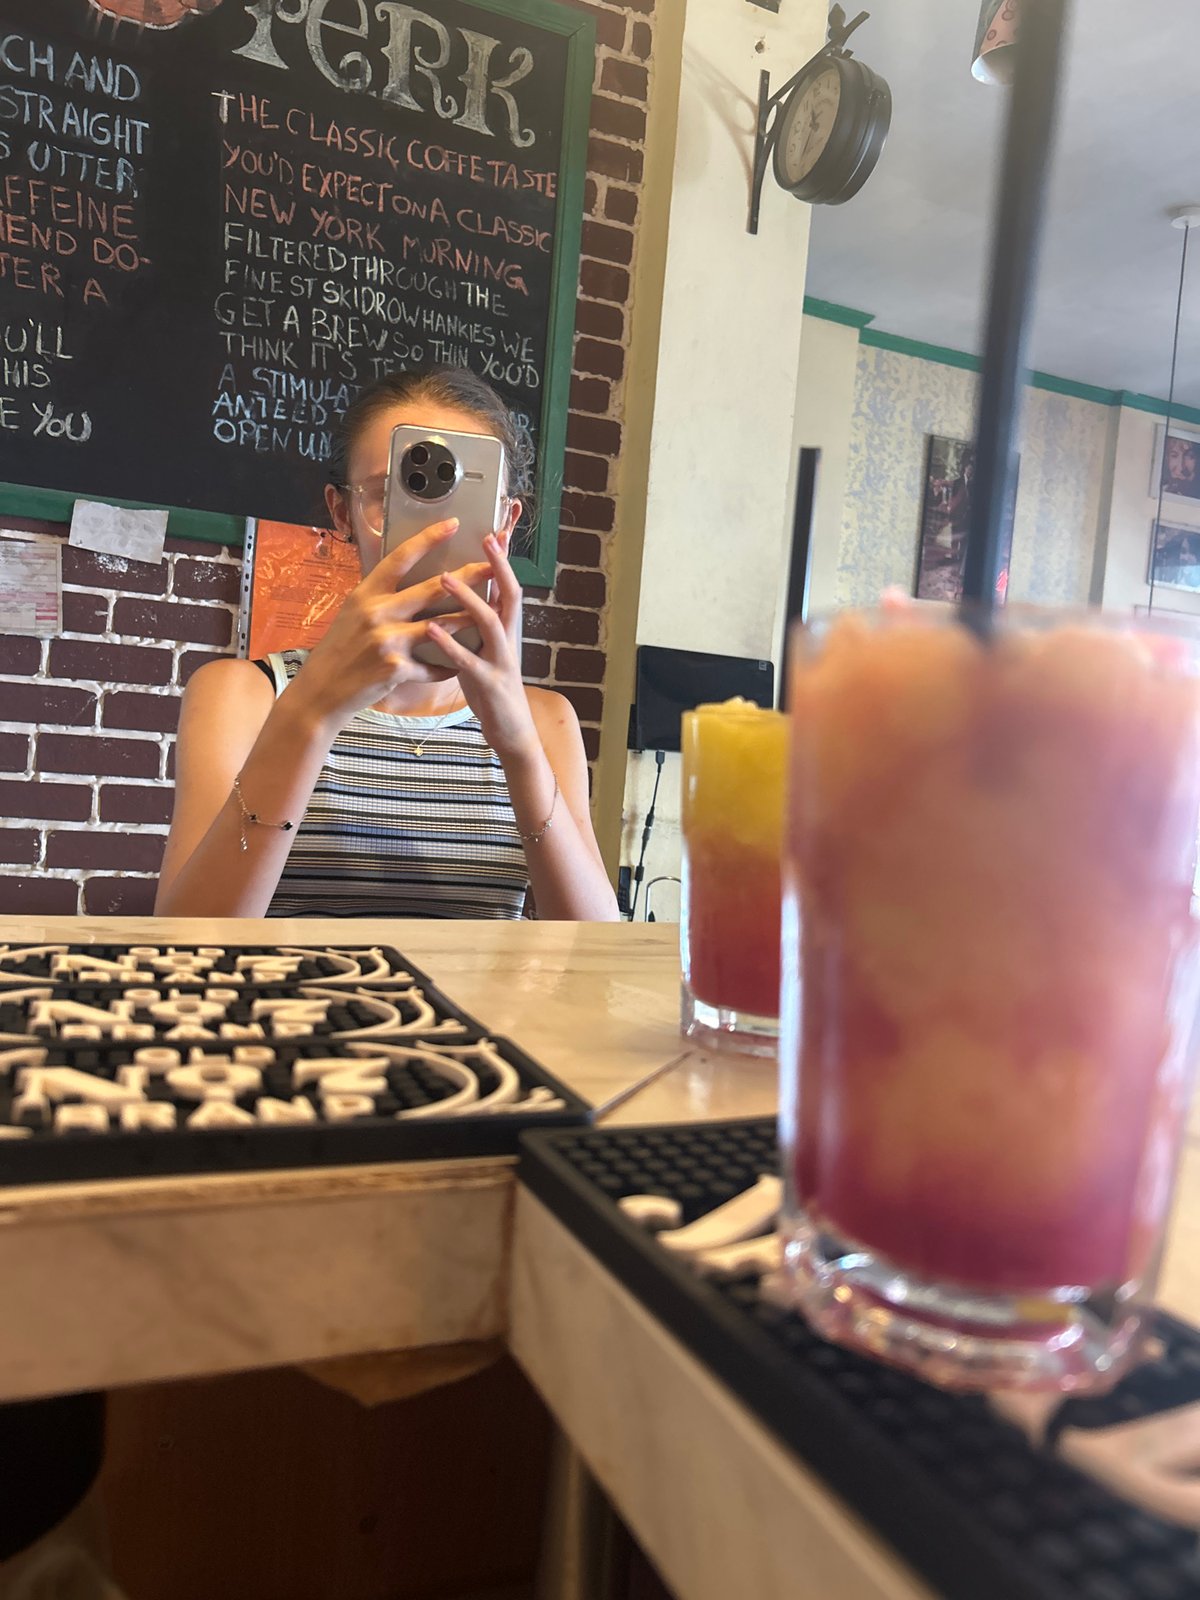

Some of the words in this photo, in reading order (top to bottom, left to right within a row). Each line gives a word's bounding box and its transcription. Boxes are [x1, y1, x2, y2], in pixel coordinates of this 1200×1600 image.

[65, 51, 141, 101] AND
[0, 84, 149, 154] STRAIGHT
[211, 89, 279, 129] THE
[286, 108, 399, 169] CLASSIC
[407, 139, 485, 184] COFFE
[486, 160, 557, 198] TASTE
[27, 141, 138, 198] UTTER
[223, 139, 294, 185] YOU'D
[302, 164, 393, 213] EXPECT
[456, 209, 552, 253] CLASSIC
[0, 175, 138, 239] FFEINE
[224, 184, 296, 226] NEW
[311, 207, 385, 251] YORK
[83, 278, 109, 305] A
[224, 222, 347, 272] FILTERED
[350, 256, 456, 300] THROUGH
[461, 282, 508, 316] THE
[214, 292, 275, 327] GET
[283, 305, 300, 338] A
[312, 308, 388, 350] BREW
[393, 331, 424, 361] SO
[428, 340, 468, 367] THIN
[480, 350, 540, 388] YOU'D
[225, 259, 317, 298] FINEST
[501, 332, 534, 362] WE
[218, 363, 236, 393] A
[219, 332, 298, 370] THINK
[311, 342, 357, 381] IT'S
[32, 402, 92, 442] YOU
[213, 418, 291, 451] OPEN
